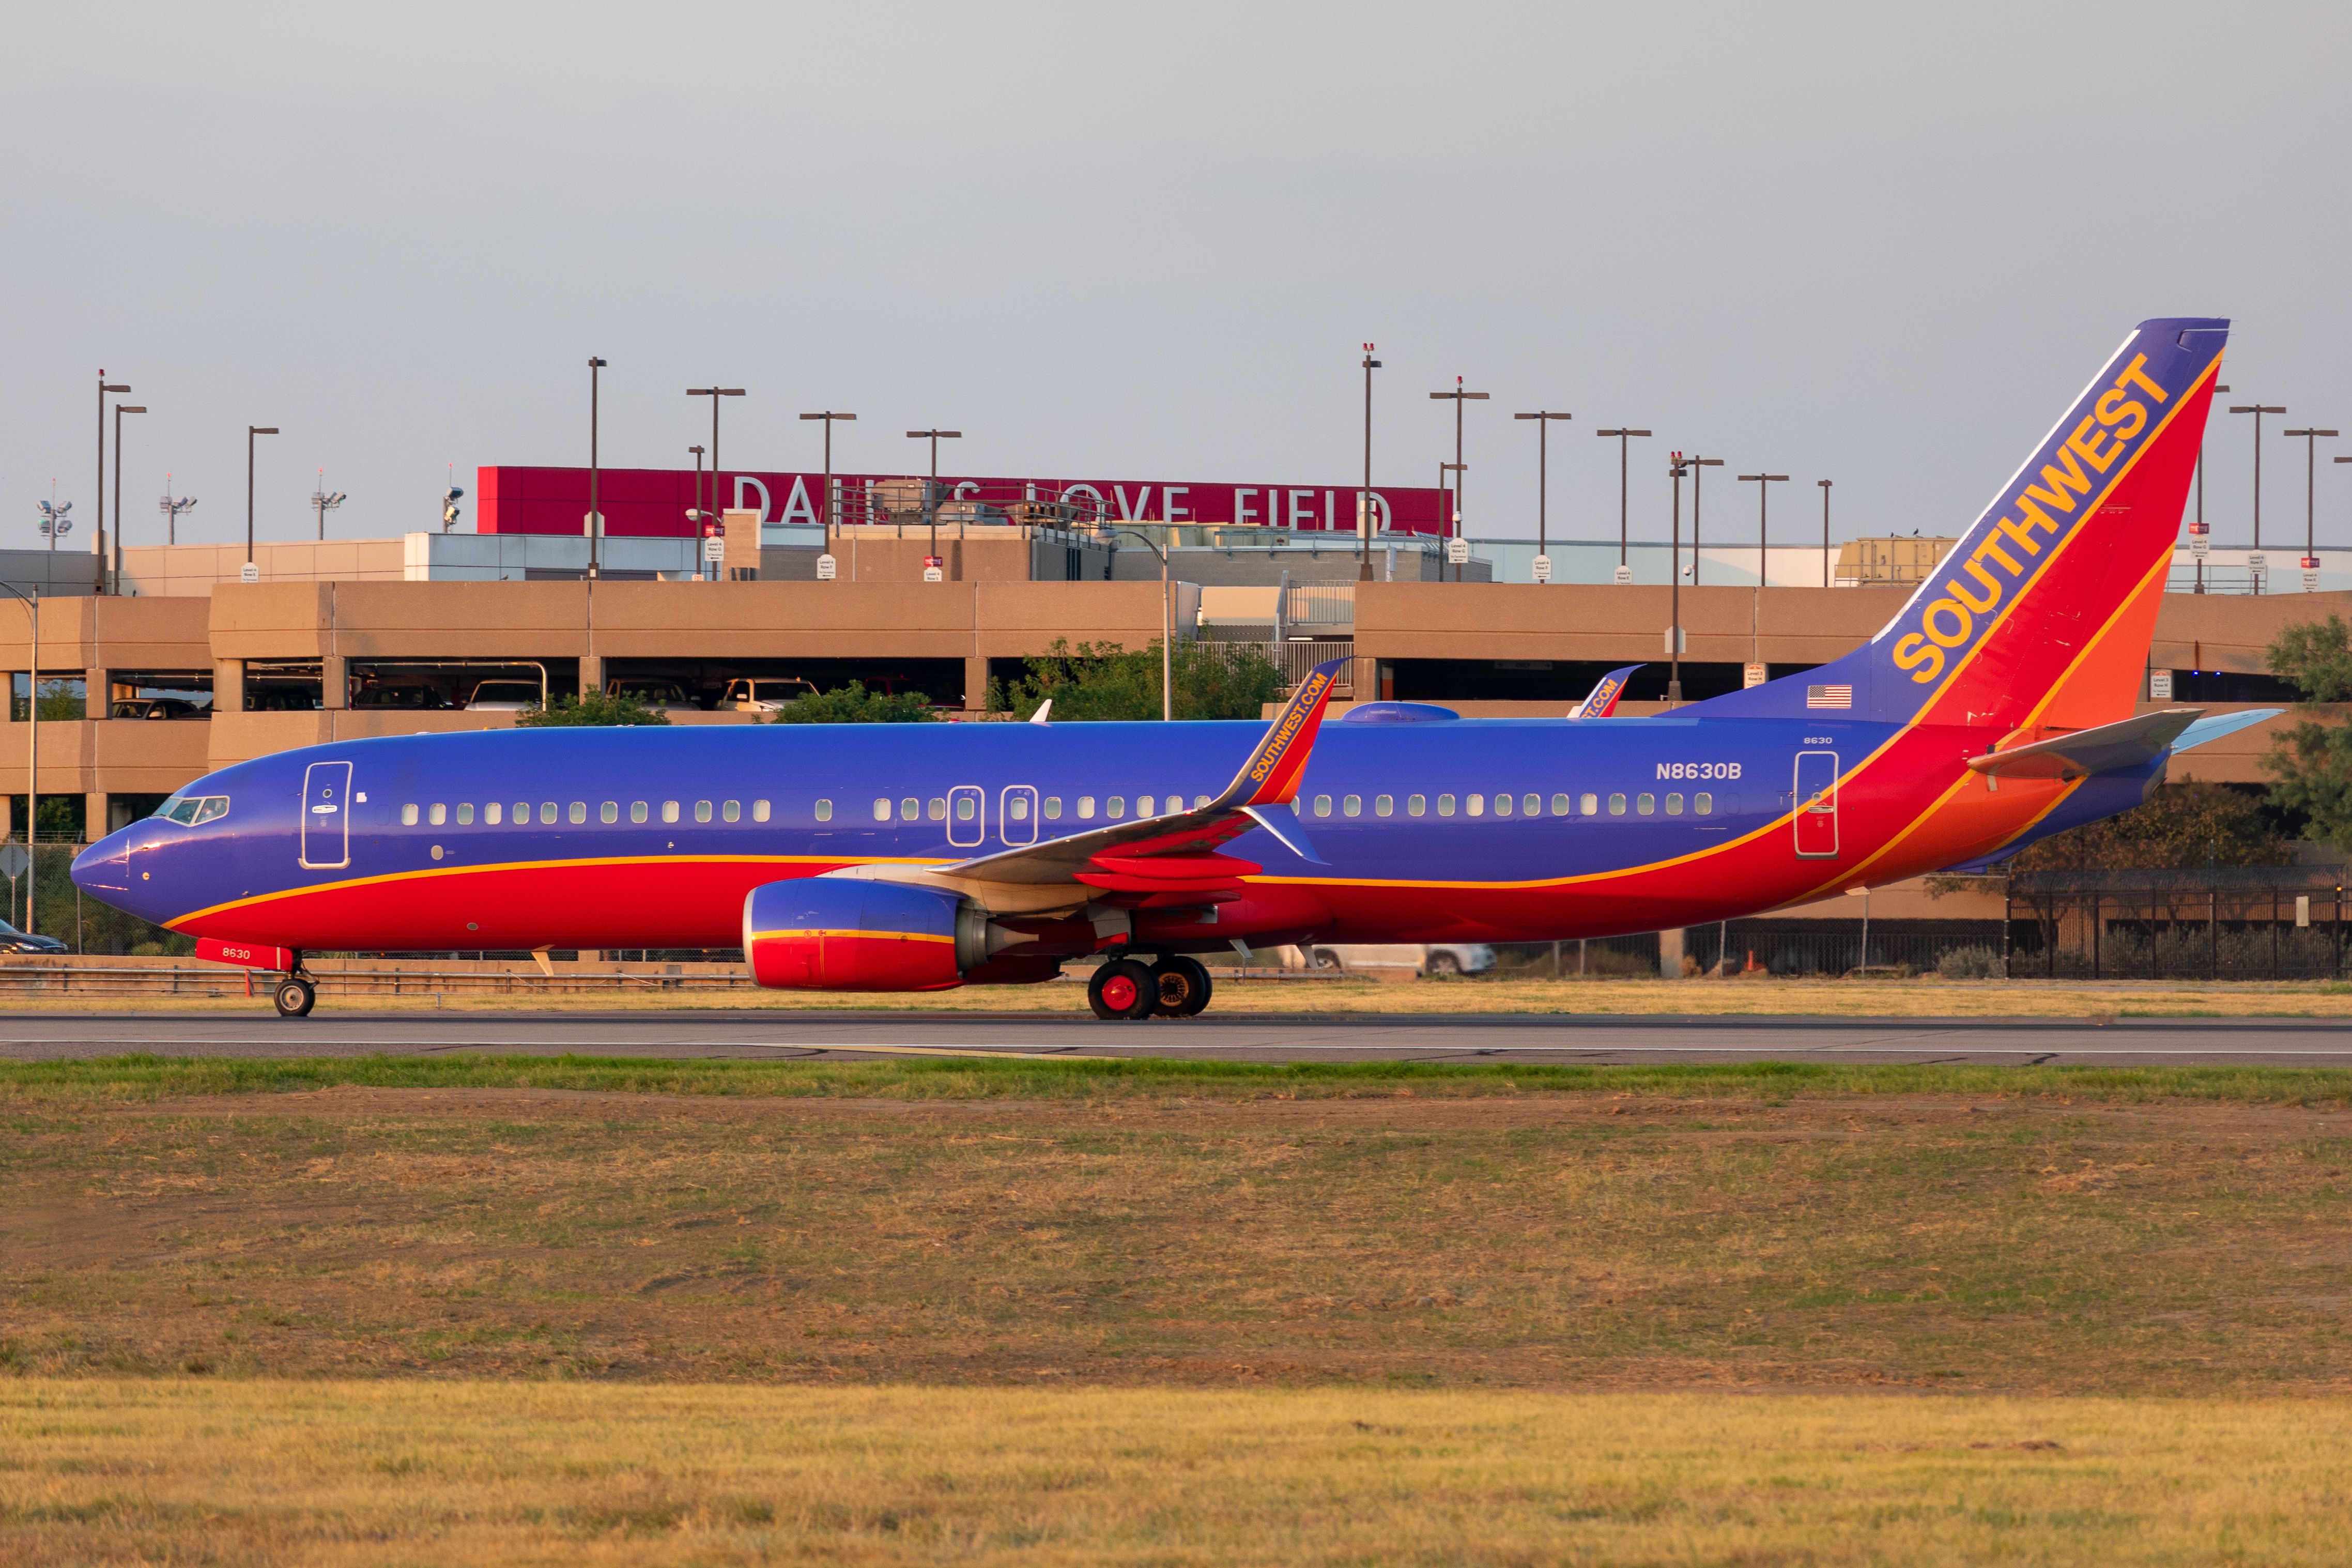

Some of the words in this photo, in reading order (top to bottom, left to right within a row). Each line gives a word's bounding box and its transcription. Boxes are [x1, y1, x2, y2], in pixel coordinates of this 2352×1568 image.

[734, 475, 980, 525] DALL
[1893, 352, 2169, 683] SOUTHWEST
[1251, 672, 1328, 782] SOUTHWEST.COM
[1656, 763, 1742, 779] N8630B
[223, 947, 250, 960] 8630
